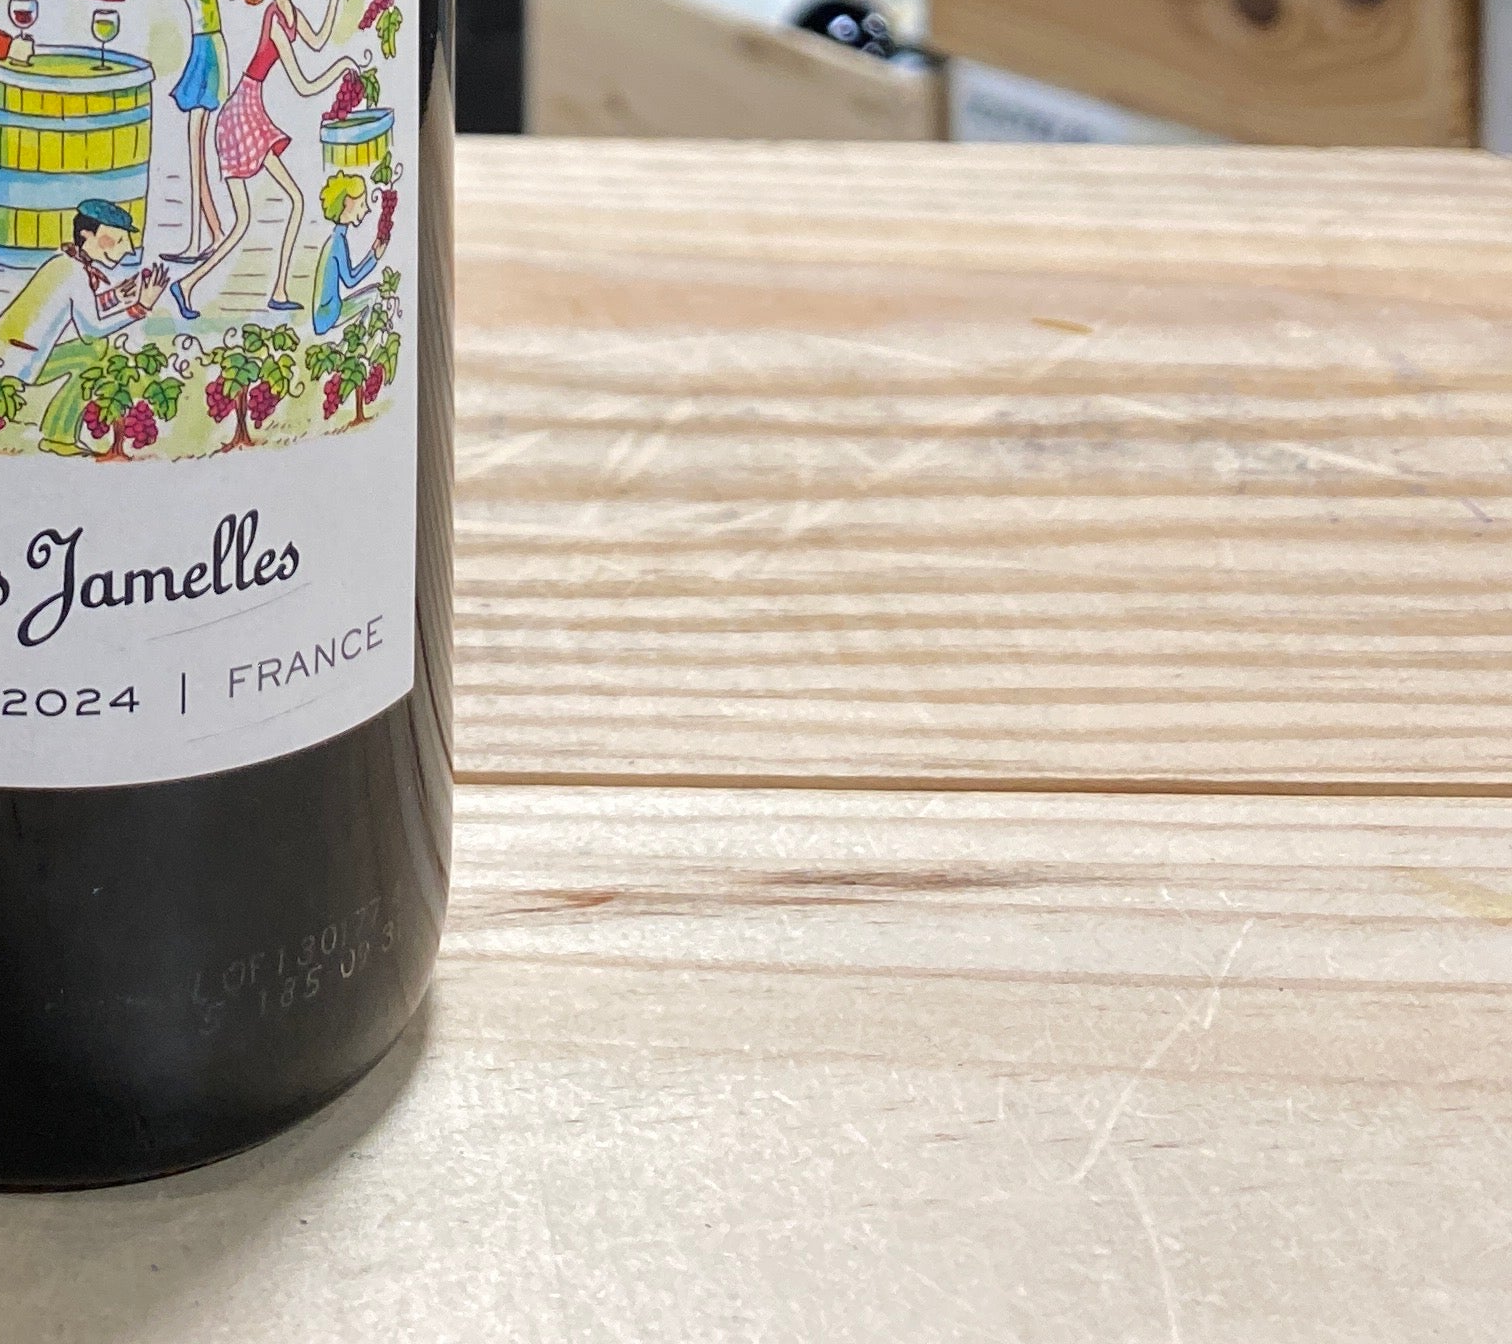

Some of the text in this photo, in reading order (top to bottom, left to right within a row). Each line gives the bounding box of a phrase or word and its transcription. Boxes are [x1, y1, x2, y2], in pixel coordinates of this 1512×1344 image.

[17, 508, 301, 647] Jamelles
[1, 685, 141, 716] 2024
[227, 614, 385, 699] FRANCE
